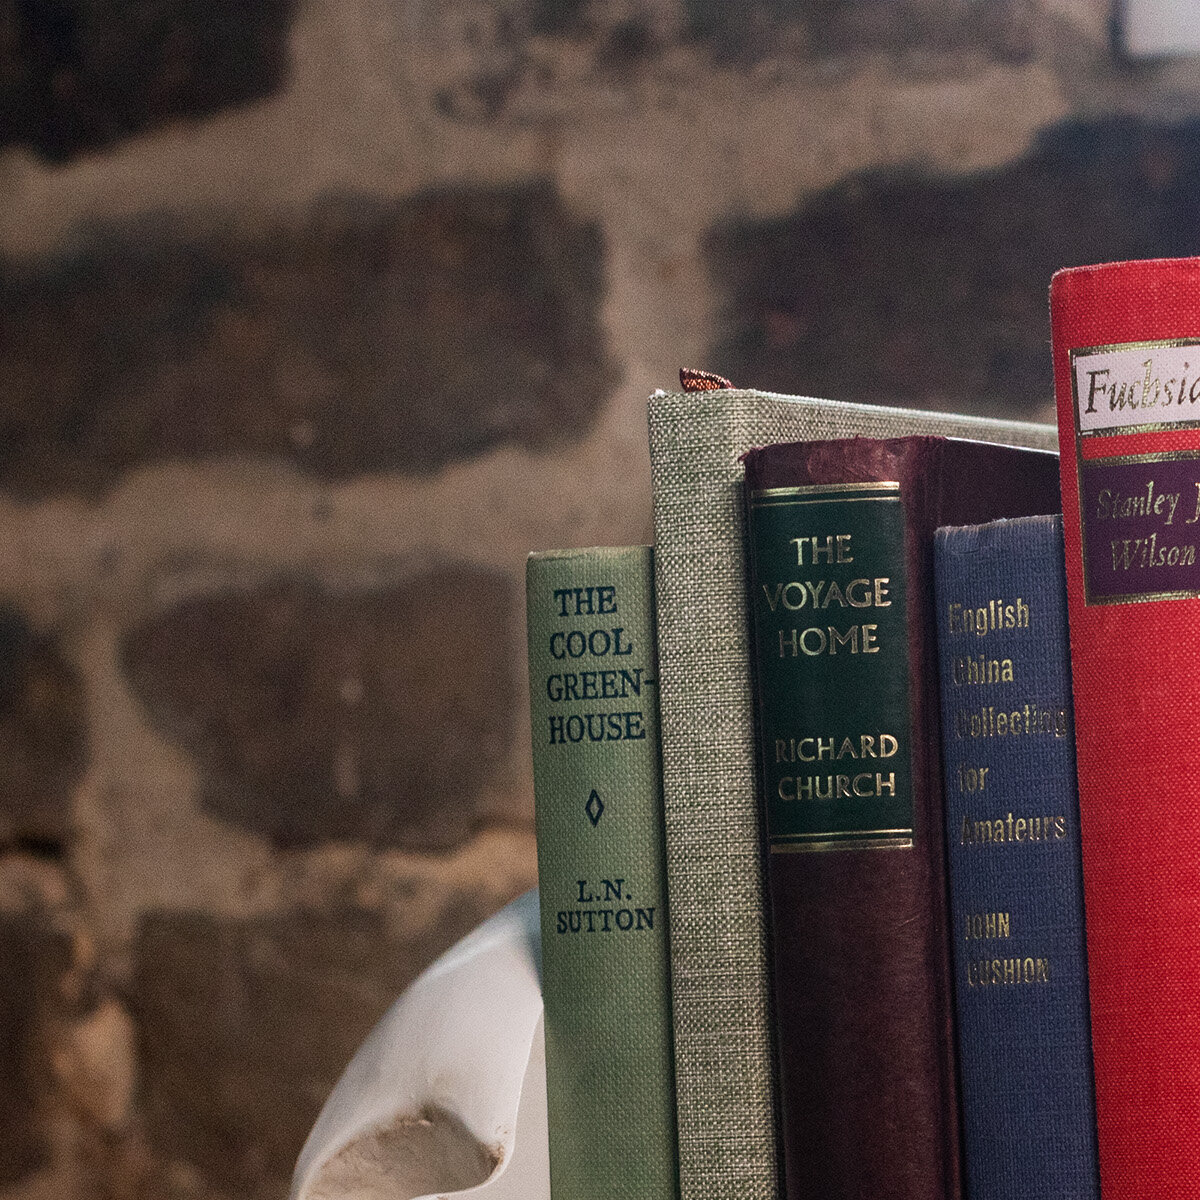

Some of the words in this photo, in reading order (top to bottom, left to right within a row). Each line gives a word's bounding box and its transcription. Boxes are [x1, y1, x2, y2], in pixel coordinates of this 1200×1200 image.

[1096, 480, 1181, 525] Stanley
[789, 533, 854, 566] THE
[1110, 533, 1197, 571] Wilson
[553, 585, 618, 618] THE
[762, 577, 893, 613] VOYAGE
[948, 597, 1030, 637] English
[549, 627, 634, 660] COOL
[778, 624, 881, 659] HOME
[546, 668, 656, 702] GREEN-
[952, 654, 1015, 686] China
[548, 711, 647, 744] HOUSE
[775, 733, 899, 764] RICHARD
[777, 771, 897, 802] CHURCH
[957, 762, 990, 793] for
[960, 812, 1067, 845] Amateurs
[576, 878, 633, 903] L.N.
[556, 907, 656, 935] SUTTON
[964, 912, 1011, 941] JOHN
[967, 957, 1051, 987] CUSHION
